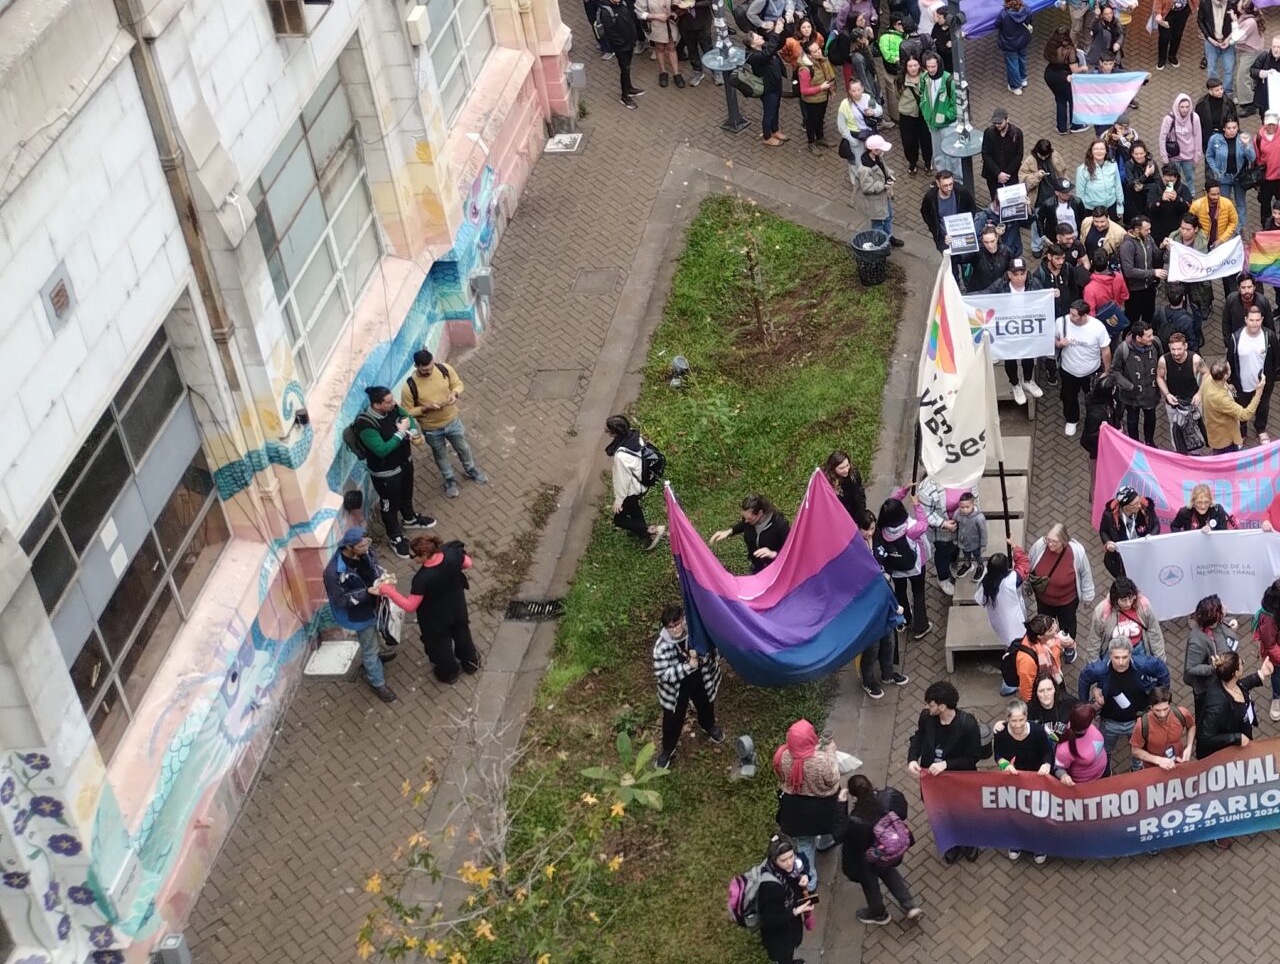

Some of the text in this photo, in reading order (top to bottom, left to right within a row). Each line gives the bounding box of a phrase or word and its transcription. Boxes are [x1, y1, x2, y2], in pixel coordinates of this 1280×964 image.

[995, 318, 1047, 336] LGBT
[981, 785, 1139, 822] ENCUENTRO
[1146, 754, 1280, 810] NACIONAL
[1219, 812, 1252, 824] JUNIO
[1254, 807, 1280, 818] 2024
